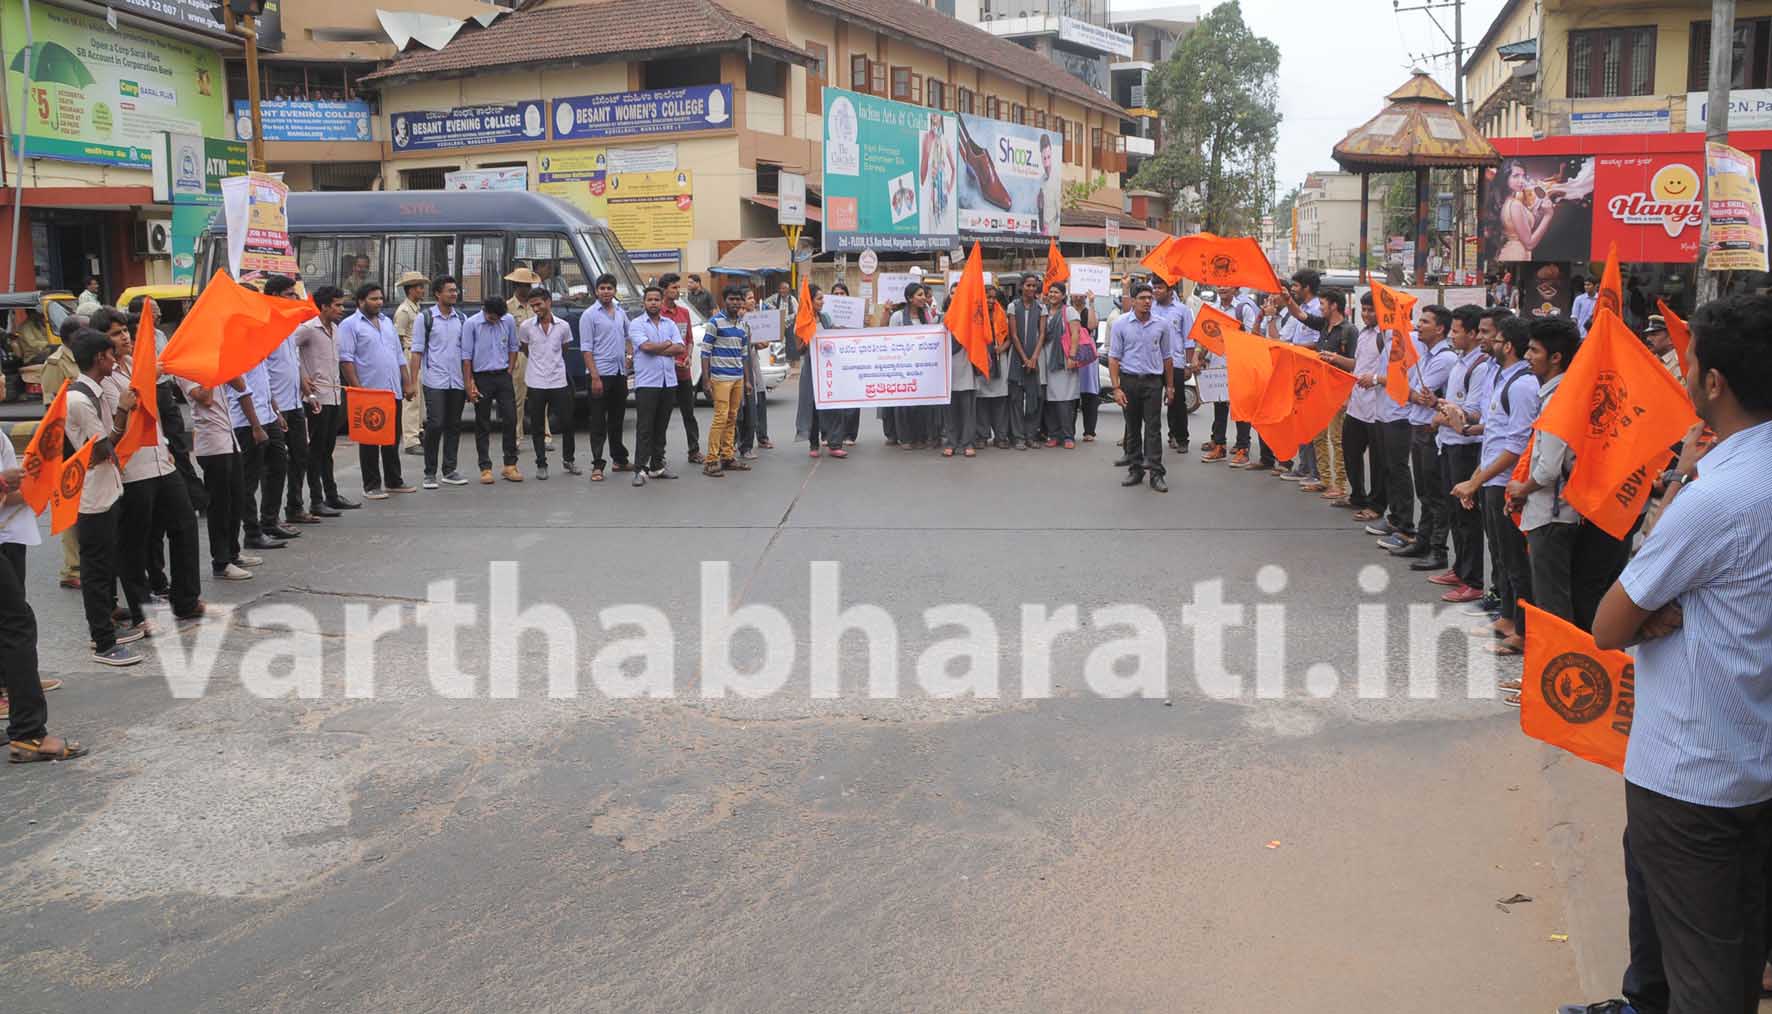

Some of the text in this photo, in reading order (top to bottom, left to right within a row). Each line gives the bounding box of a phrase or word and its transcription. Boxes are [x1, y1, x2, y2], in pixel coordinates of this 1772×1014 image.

[90, 38, 109, 52] Open
[86, 50, 115, 65] Account
[122, 57, 158, 74] Corporation
[239, 110, 276, 118] BEANT
[280, 110, 322, 118] EVENING
[576, 99, 704, 124] BESANT WOMEN'S COLLEGE
[412, 114, 521, 135] BESANT EVENING COLLEGE
[206, 157, 227, 176] ATM
[865, 378, 918, 398] ಪ್ರತಿಭಟನೆ
